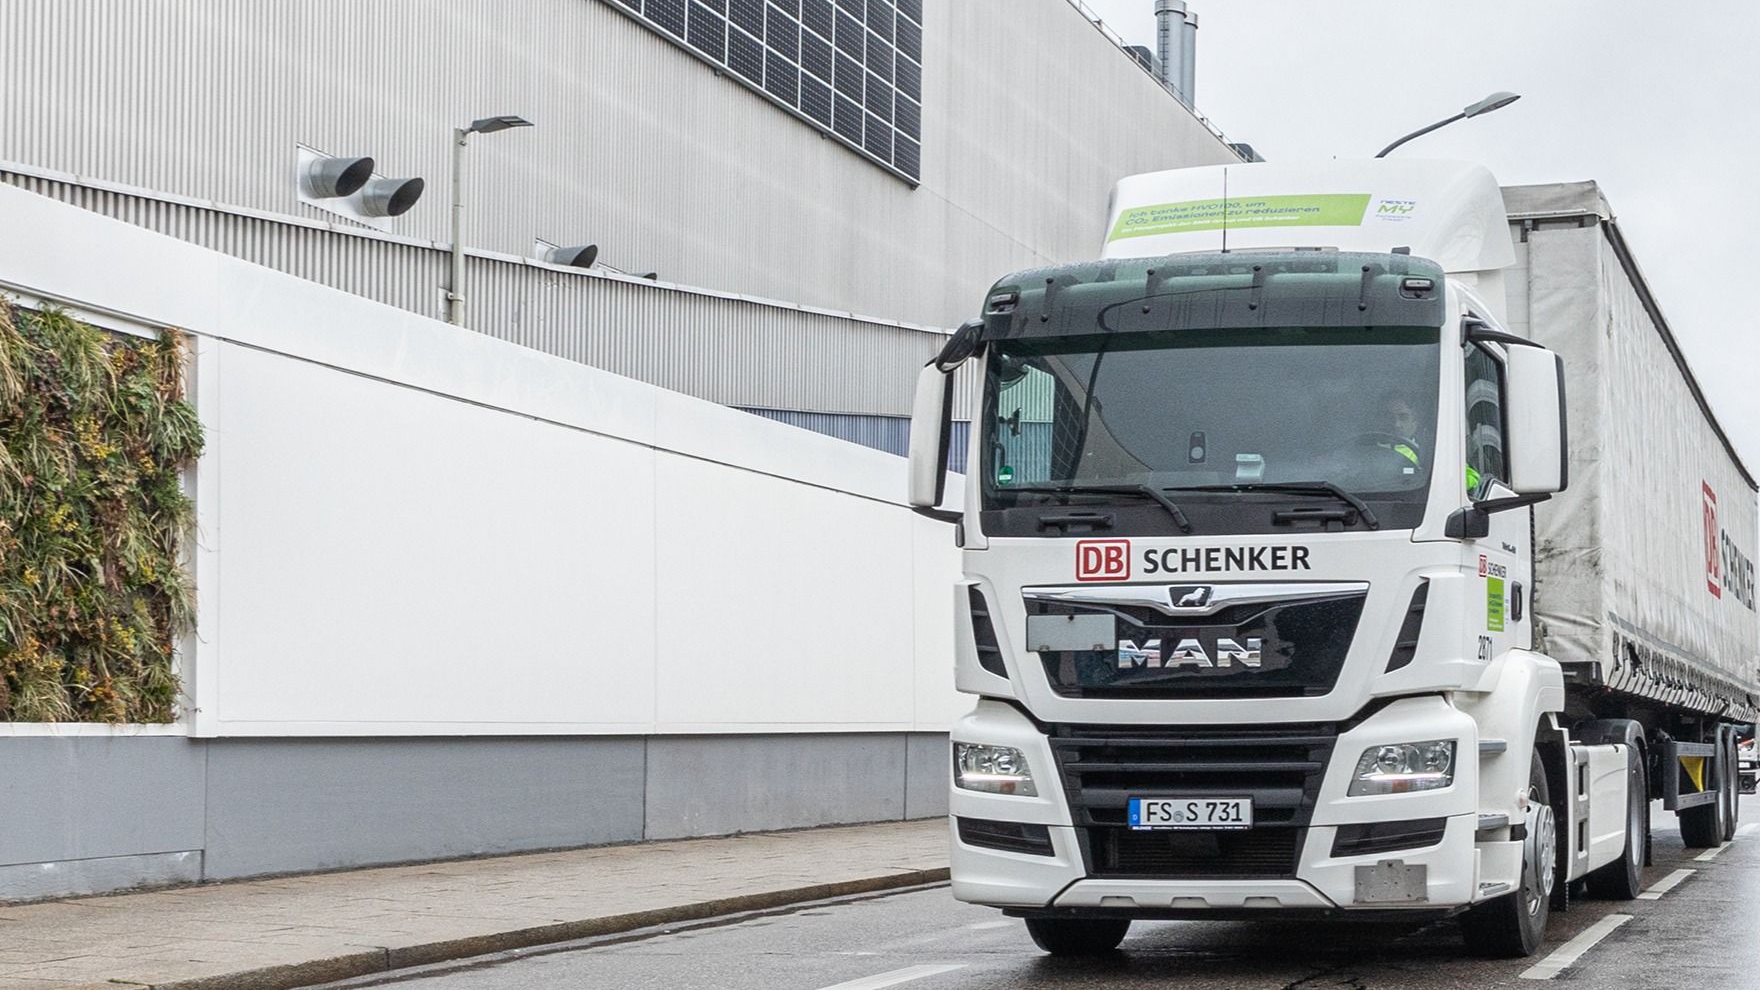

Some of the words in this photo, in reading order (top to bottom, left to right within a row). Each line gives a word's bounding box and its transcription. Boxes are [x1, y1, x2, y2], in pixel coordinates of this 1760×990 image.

[1151, 211, 1226, 222] Emissionen
[1245, 206, 1321, 215] reduzieren
[1377, 204, 1415, 214] MY
[1082, 545, 1125, 576] DB
[1143, 545, 1312, 574] SCHENKER
[1703, 496, 1719, 580] DB
[1720, 527, 1757, 613] SCHENKER
[1118, 638, 1262, 668] MAN
[1146, 802, 1172, 822] FS
[1186, 802, 1199, 822] S
[1205, 802, 1243, 822] 731
